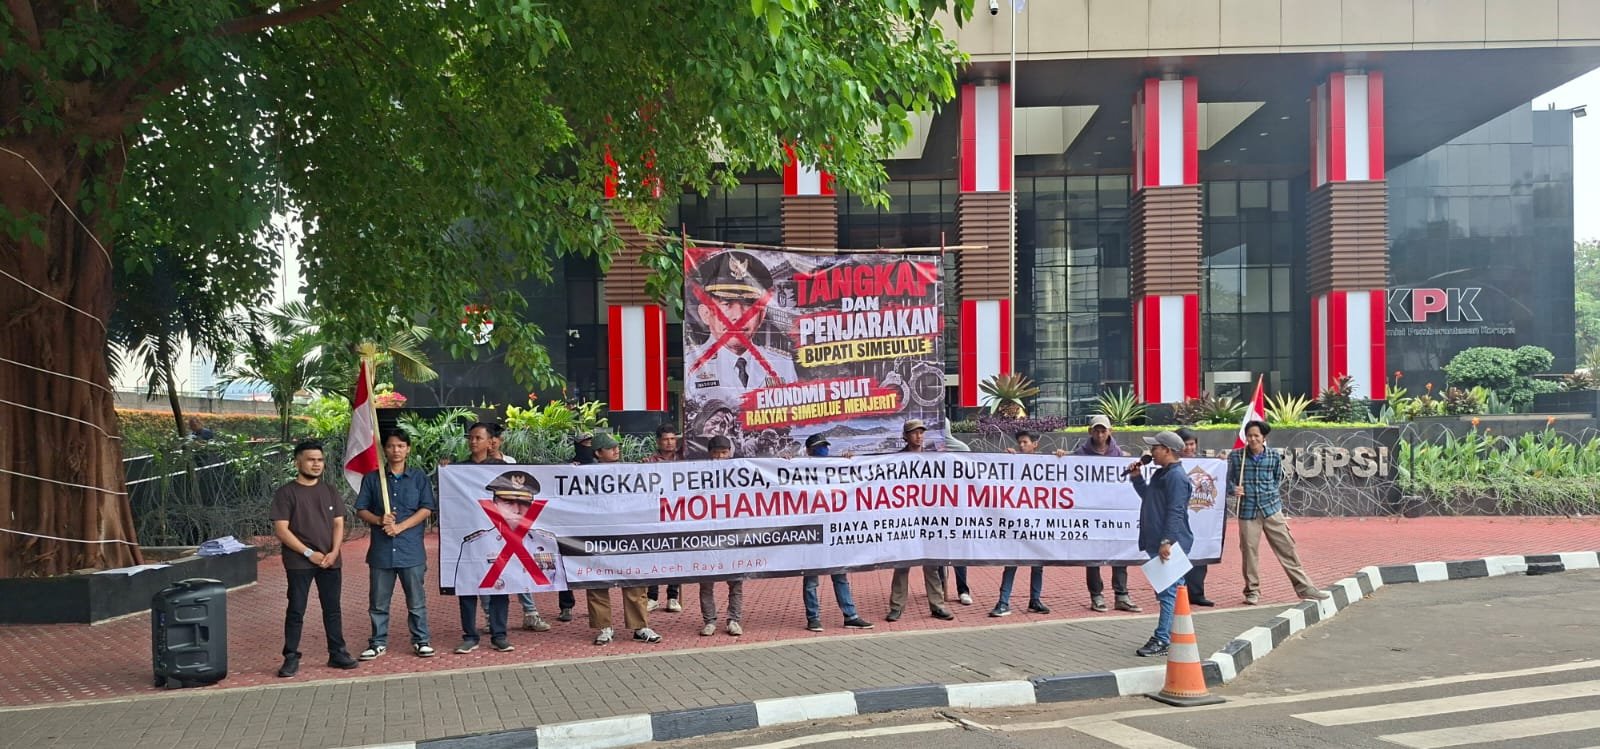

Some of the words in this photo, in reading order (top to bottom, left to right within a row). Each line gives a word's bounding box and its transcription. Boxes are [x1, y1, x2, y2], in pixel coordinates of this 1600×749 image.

[792, 262, 938, 307] TANGKAP
[841, 296, 880, 312] DAN
[1385, 287, 1483, 322] KPK
[799, 306, 938, 345] PENJARAKAN
[805, 343, 853, 364] BUPATI
[857, 338, 927, 358] SIMEULUE
[756, 381, 827, 409] EKONOMI
[831, 378, 871, 400] SULIT
[746, 411, 788, 426] RAKYAT
[791, 403, 842, 421] SIMEULUE
[844, 394, 897, 413] MENJERIT
[554, 473, 664, 496] TANGKAP,
[673, 467, 770, 491] PERIKSA,
[778, 466, 817, 486] DAN
[825, 460, 946, 485] PENJARAKAN
[953, 461, 1014, 481] BUPATI
[1021, 463, 1067, 482] ACEH
[659, 488, 848, 521] MOHAMMAD
[855, 484, 958, 511] NASRUN
[967, 485, 1074, 510] MIKARIS
[830, 521, 868, 533] BIAYA
[873, 516, 949, 530] PERJALANAN
[955, 517, 993, 527] DINAS
[999, 517, 1040, 530] Rp18,7
[1046, 518, 1089, 529] MILIAR
[1094, 519, 1131, 529] Tahun
[830, 531, 883, 546] JAMUAN
[887, 529, 916, 541] TAMU
[920, 528, 957, 541] Rp1,5
[962, 529, 1007, 540] MILIAR
[1012, 530, 1055, 540] TAHUN
[1060, 531, 1089, 541] 2026
[584, 540, 639, 553] DIDUGA
[642, 537, 678, 550] KUAT
[681, 533, 740, 549] KORUPSI
[743, 529, 820, 546] ANGGARAN:
[732, 558, 769, 570] (PAR)
